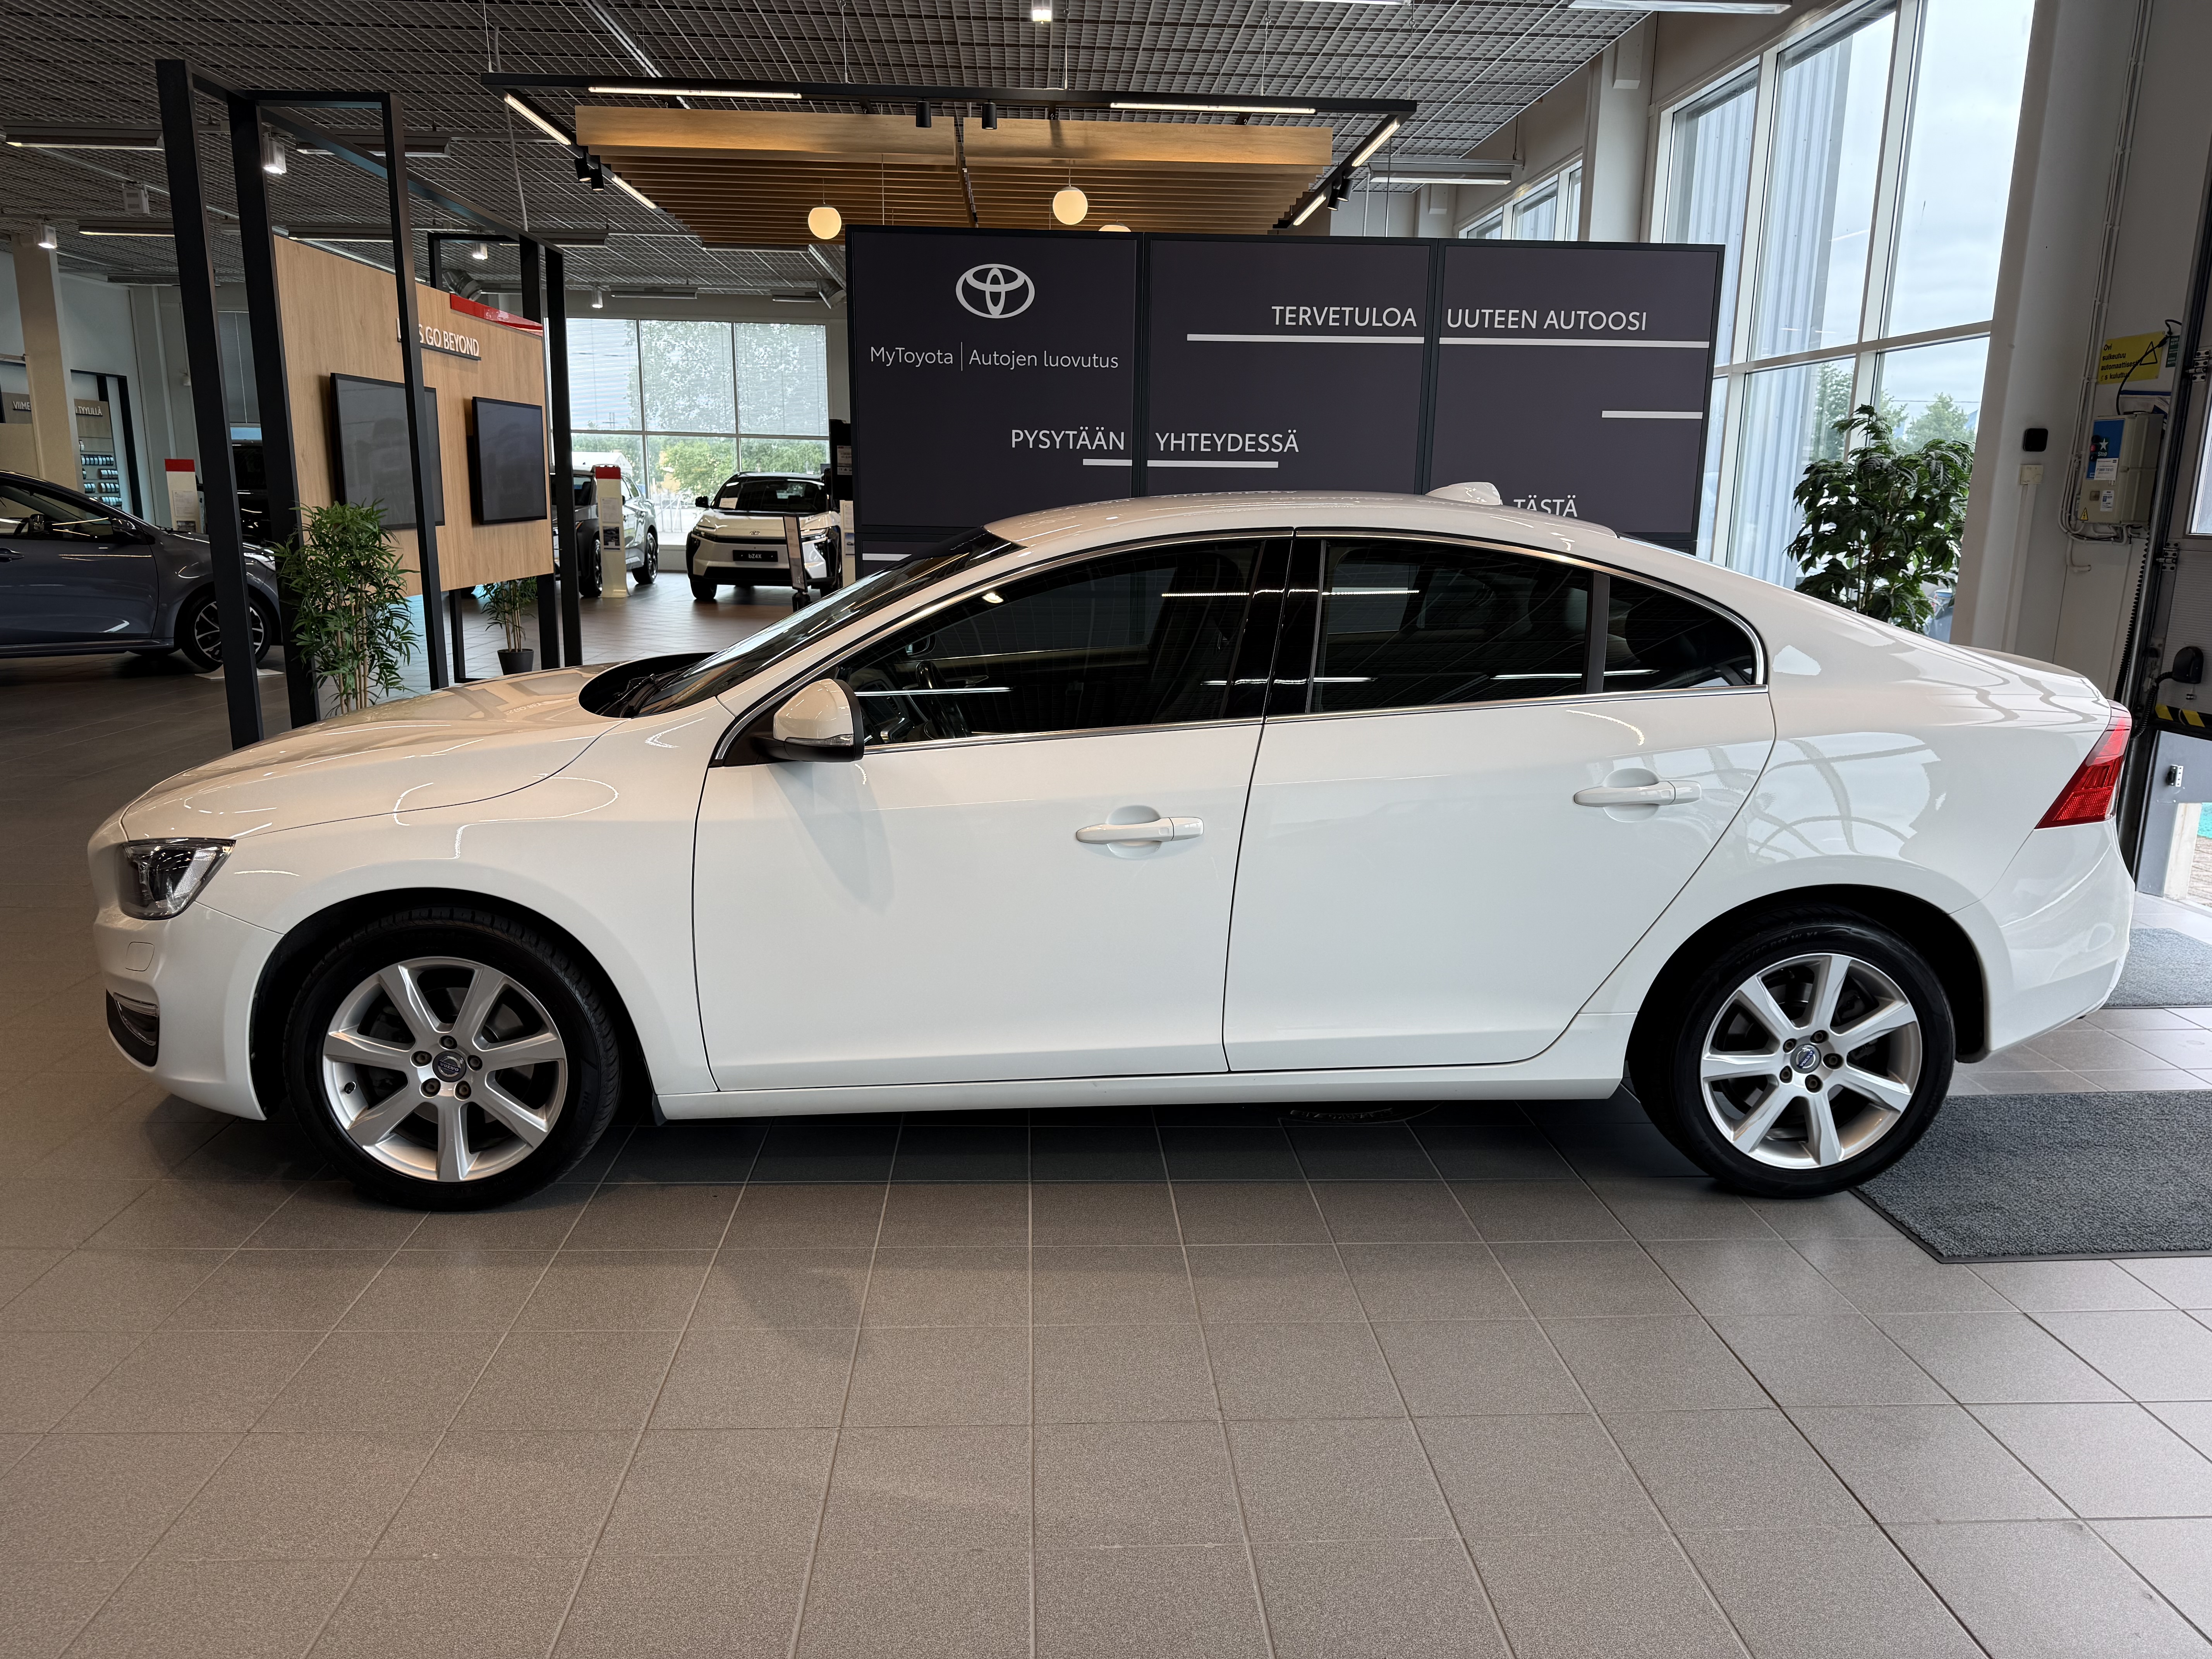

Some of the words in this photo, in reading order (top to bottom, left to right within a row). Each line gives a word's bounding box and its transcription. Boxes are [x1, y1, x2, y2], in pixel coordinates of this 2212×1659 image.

[1272, 306, 1417, 327] TERVETULOA
[1447, 309, 1537, 329] UUTEEN
[1544, 311, 1647, 330] AUTOOSI
[426, 326, 441, 347] GO
[443, 331, 479, 356] BEYOND
[871, 347, 953, 367] MyToyota
[969, 350, 1037, 369] Autojen
[1044, 351, 1118, 368] luovutus
[78, 406, 103, 415] TYYLILLÄ
[1012, 427, 1124, 450] PYSYTÄÄN
[1156, 430, 1299, 452] YHTEYDESSÄ
[1513, 495, 1577, 517] TÄSTÄ
[440, 1062, 459, 1072] VOLVO
